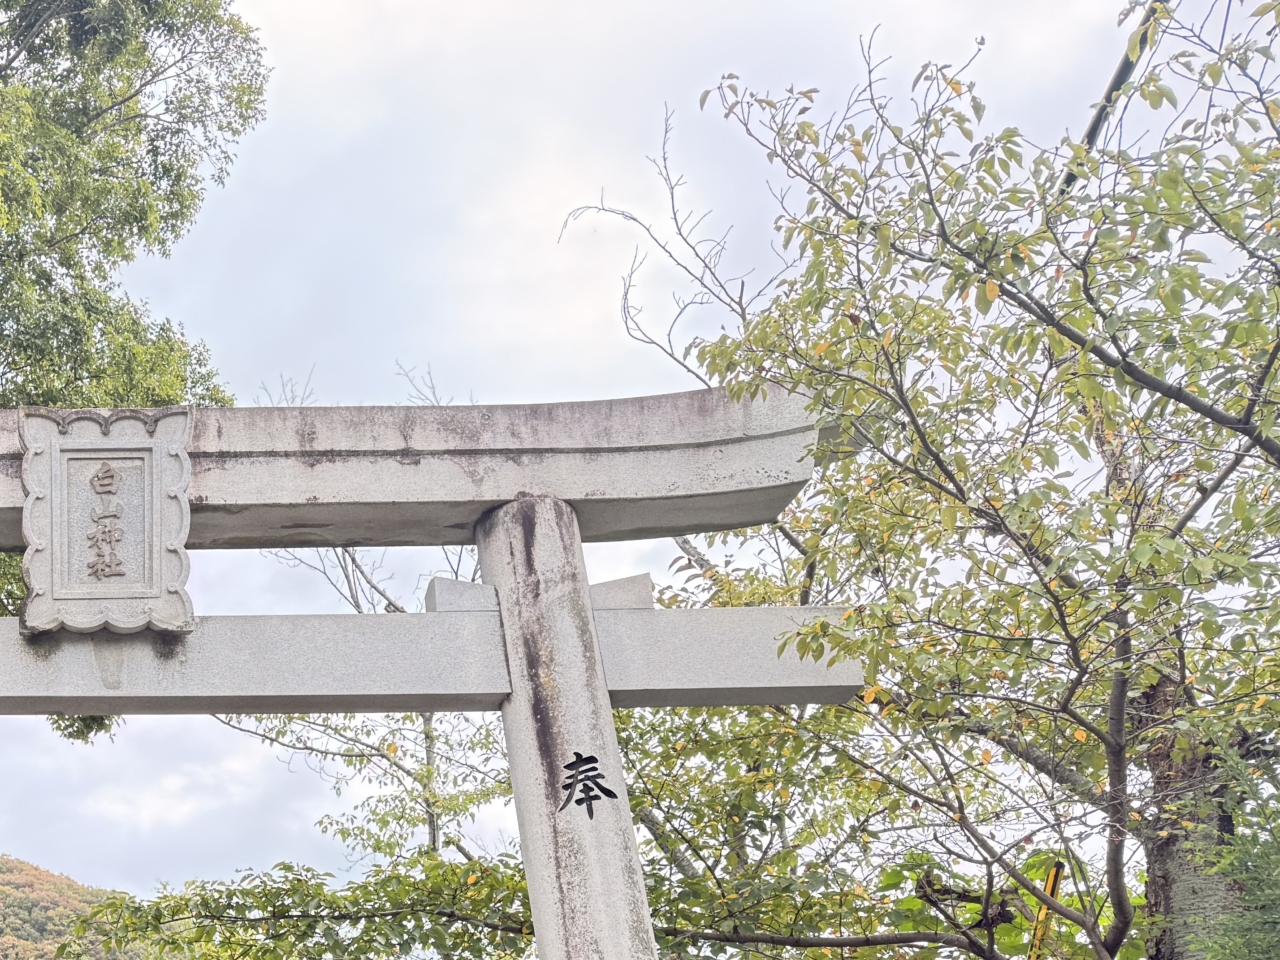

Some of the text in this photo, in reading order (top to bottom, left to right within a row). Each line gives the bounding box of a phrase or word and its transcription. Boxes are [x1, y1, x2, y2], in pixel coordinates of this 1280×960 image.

[87, 461, 126, 581] 白山神社
[558, 751, 618, 820] 奉
